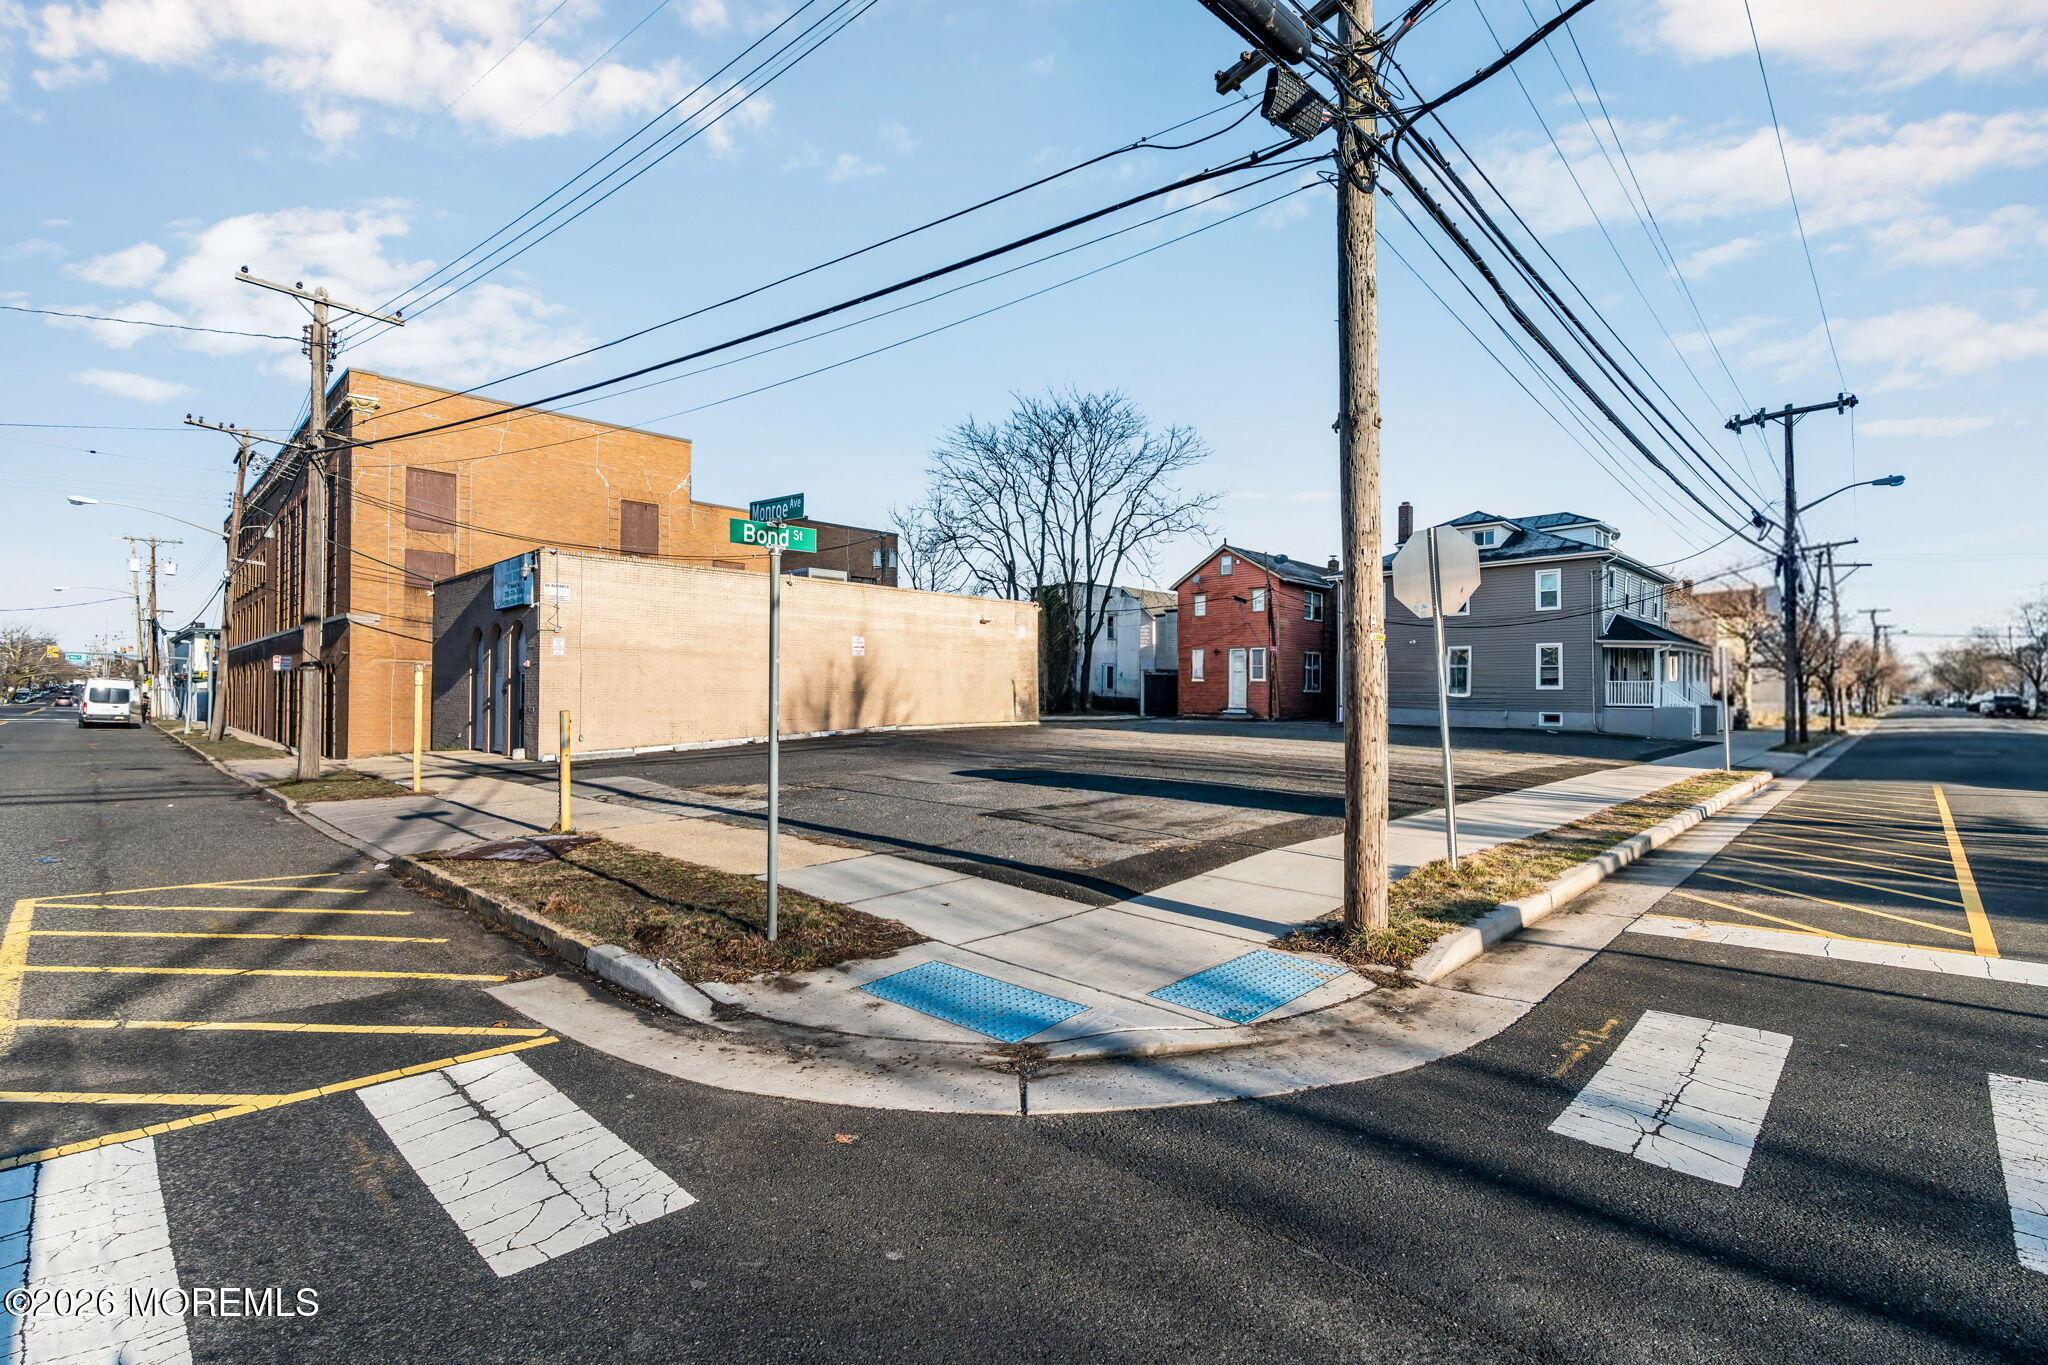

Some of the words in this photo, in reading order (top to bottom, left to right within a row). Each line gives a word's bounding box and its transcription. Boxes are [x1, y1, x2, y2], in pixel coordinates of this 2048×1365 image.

[752, 504, 788, 522] Monroe
[790, 498, 801, 508] Ave
[744, 524, 789, 547] Bond
[793, 530, 803, 541] St
